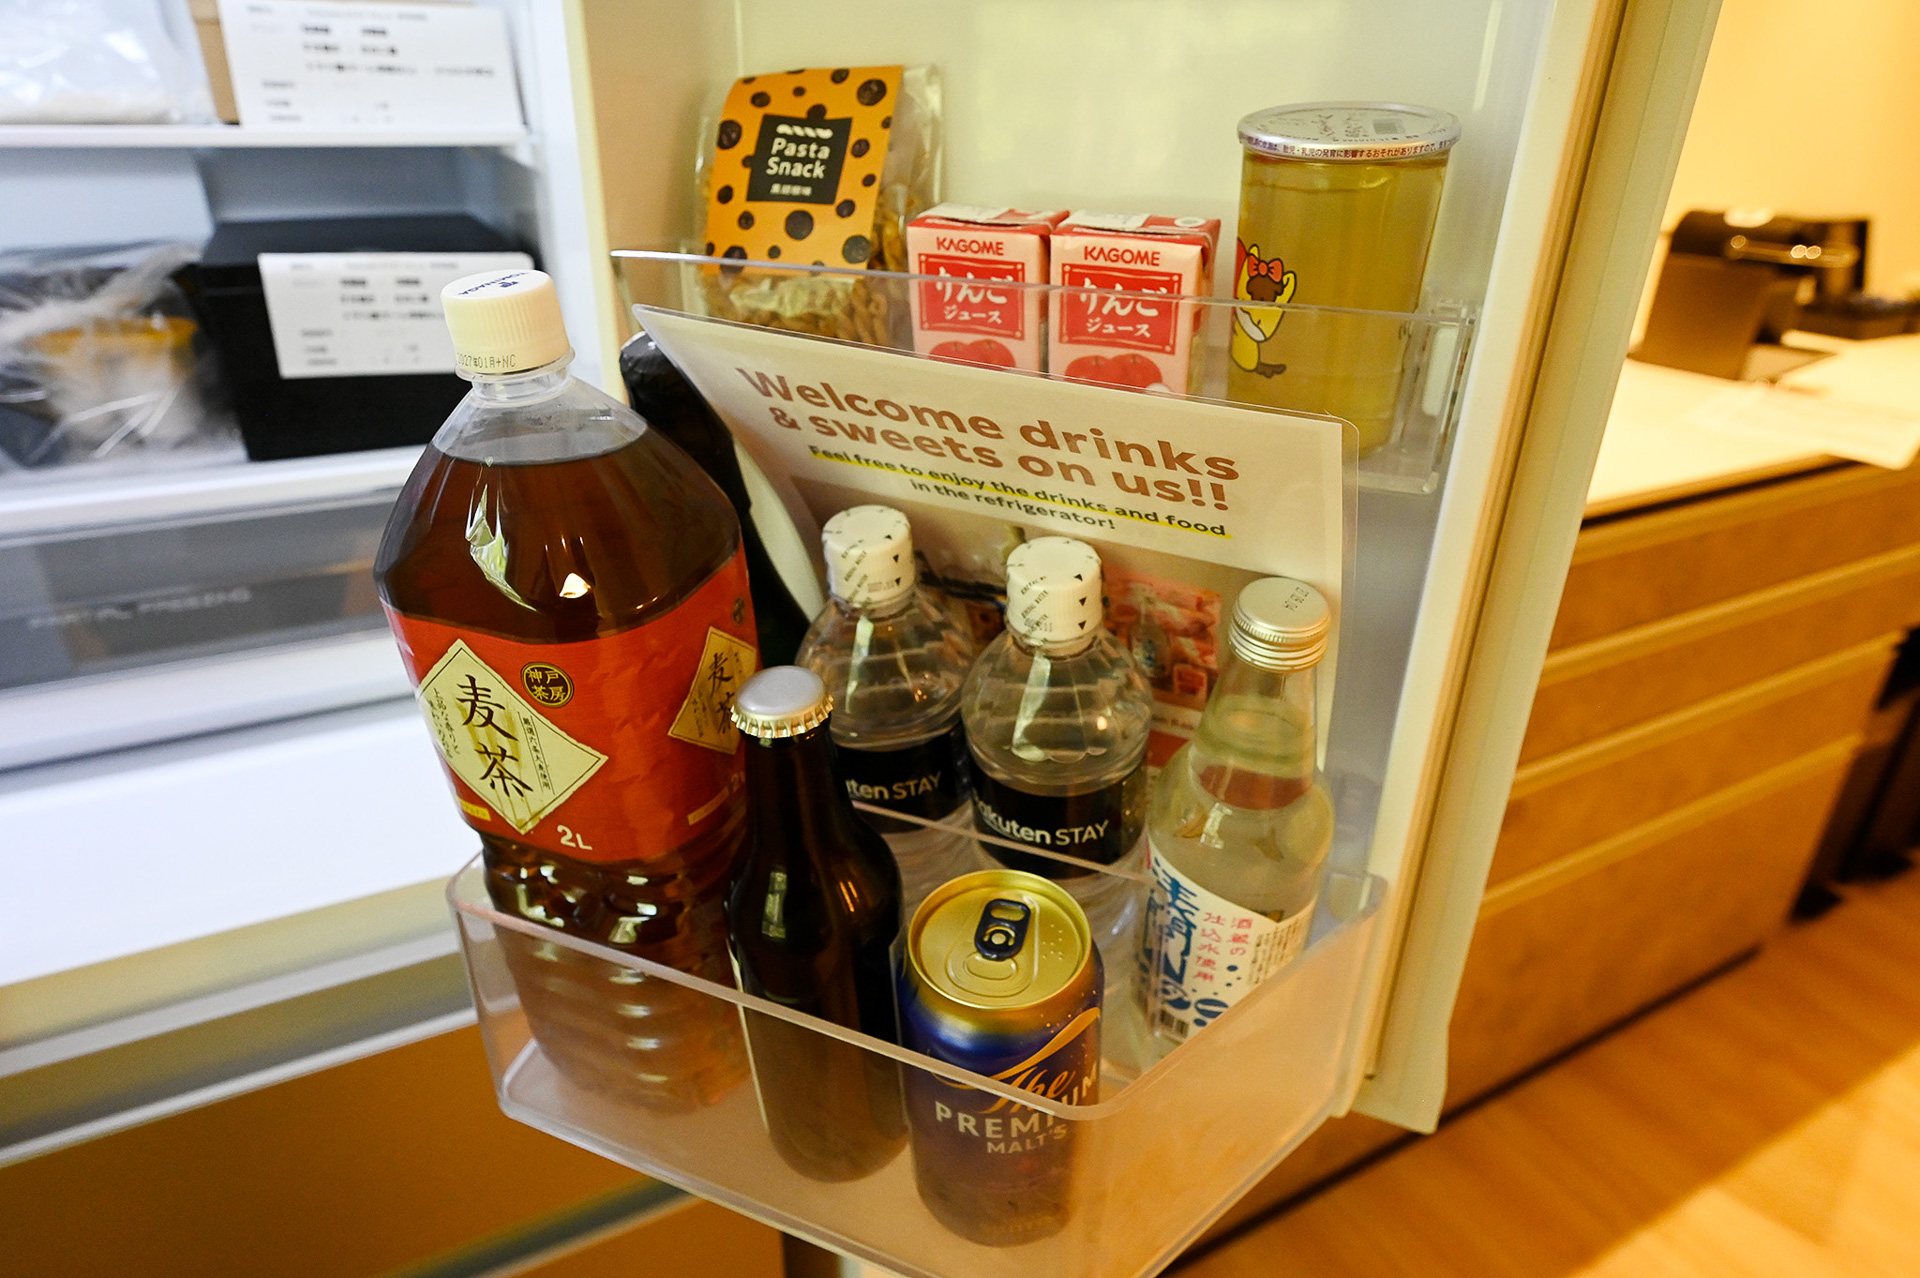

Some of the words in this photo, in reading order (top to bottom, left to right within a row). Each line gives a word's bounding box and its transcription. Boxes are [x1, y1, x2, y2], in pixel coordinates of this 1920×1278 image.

[771, 137, 831, 160] Pasta
[765, 156, 826, 179] Snack
[936, 236, 1004, 256] KAGOME
[1084, 245, 1161, 267] KAGOME
[935, 266, 1014, 304] りんご
[1080, 277, 1168, 316] りんご
[943, 305, 1002, 324] ジュース
[1086, 318, 1151, 338] ジュース
[735, 367, 1004, 440] Welcome
[1019, 419, 1240, 481] drinks
[769, 407, 801, 431] &
[808, 415, 1004, 469] sweets
[1018, 455, 1096, 487] on
[1112, 471, 1229, 511] us!!
[808, 445, 851, 463] Feel
[853, 453, 897, 472] free
[900, 463, 924, 477] to
[928, 470, 985, 491] enjoy
[991, 481, 1029, 498] the
[1034, 490, 1108, 513] drinks
[1115, 507, 1159, 523] and
[1165, 514, 1226, 536] food
[909, 478, 931, 493] in
[934, 484, 970, 500] the
[975, 493, 1116, 530] refrigerator!
[528, 668, 561, 685] 神戸
[533, 685, 566, 702] 茶房
[456, 674, 534, 797] 麦茶
[892, 771, 942, 799] STAY
[556, 825, 593, 851] 2L
[1055, 819, 1110, 846] STAY
[986, 1123, 1067, 1154] MALT'S
